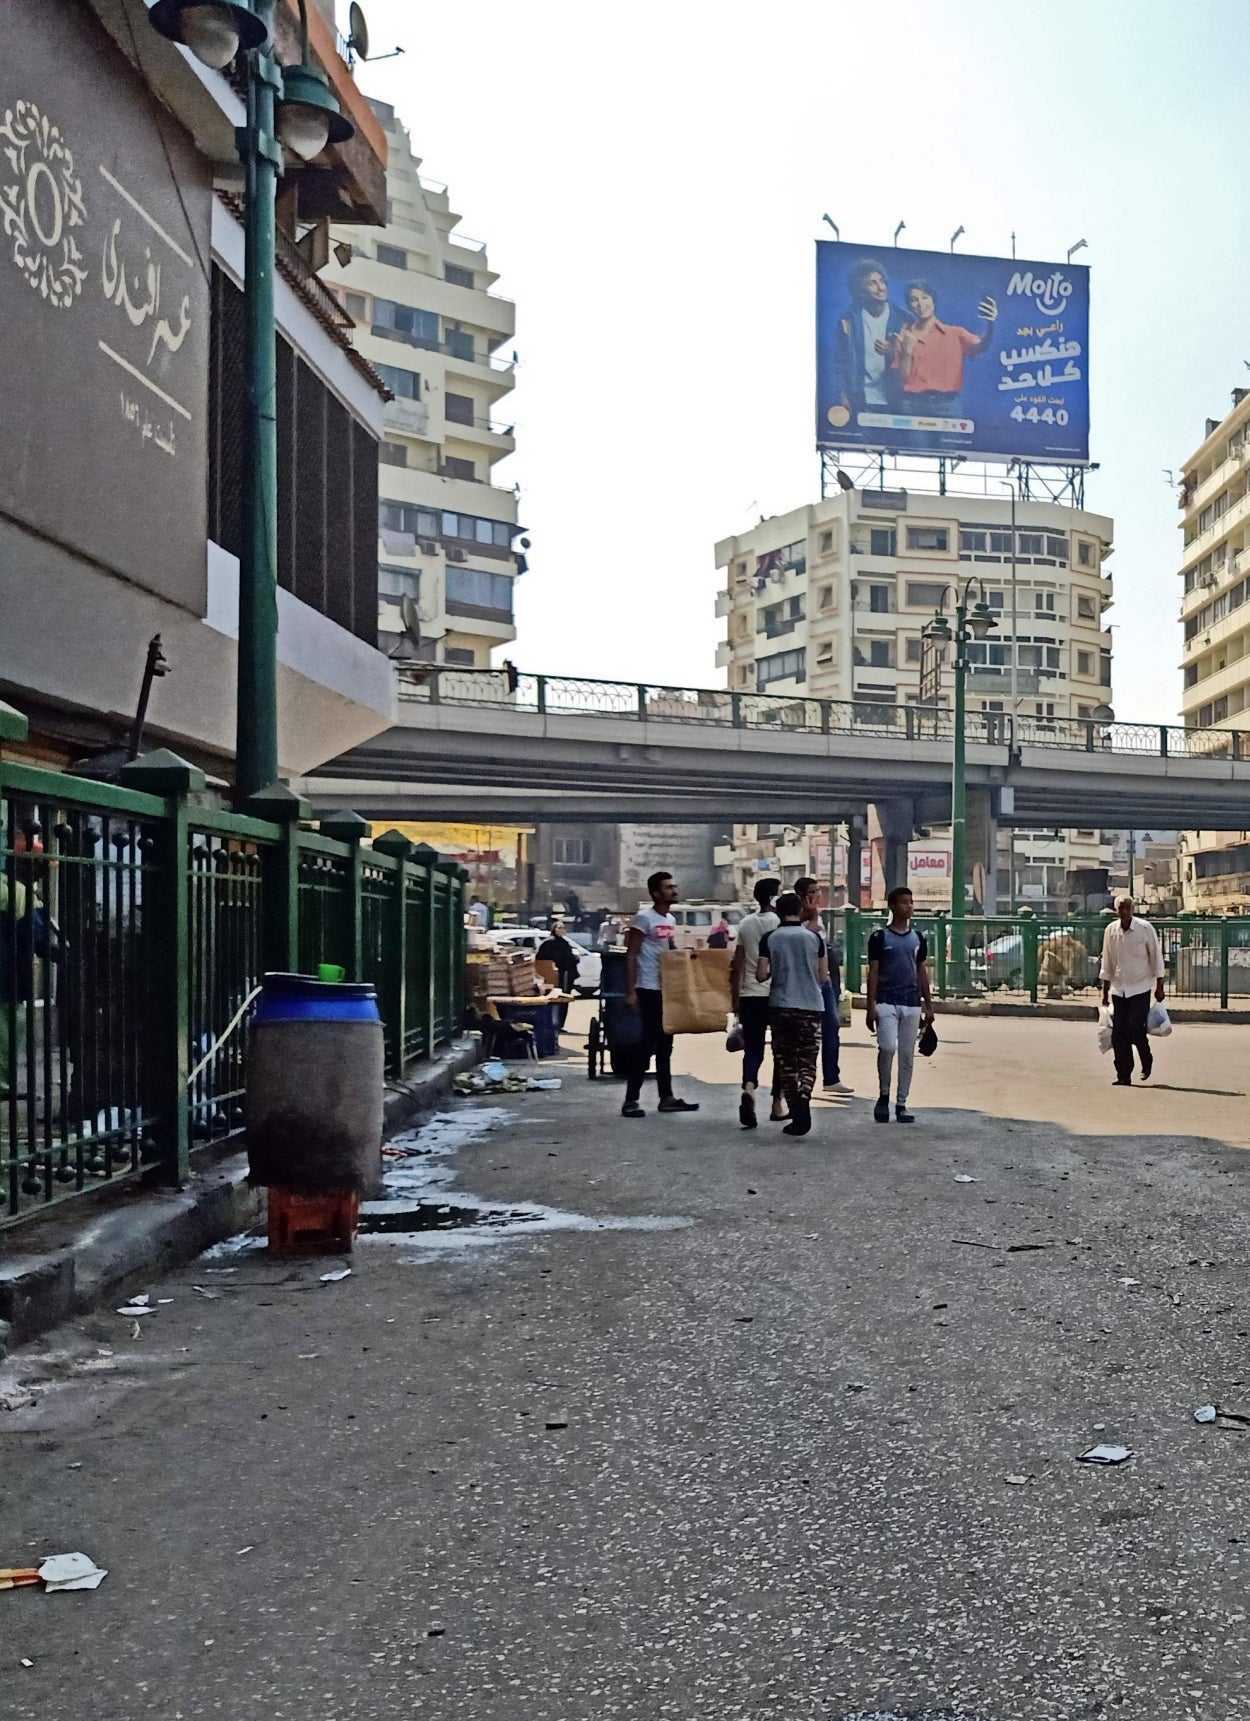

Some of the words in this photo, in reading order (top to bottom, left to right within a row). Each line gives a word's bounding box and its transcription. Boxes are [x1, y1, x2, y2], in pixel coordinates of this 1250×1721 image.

[1006, 271, 1073, 305] Molto
[1010, 405, 1069, 426] 4440
[910, 855, 945, 871] معامل
